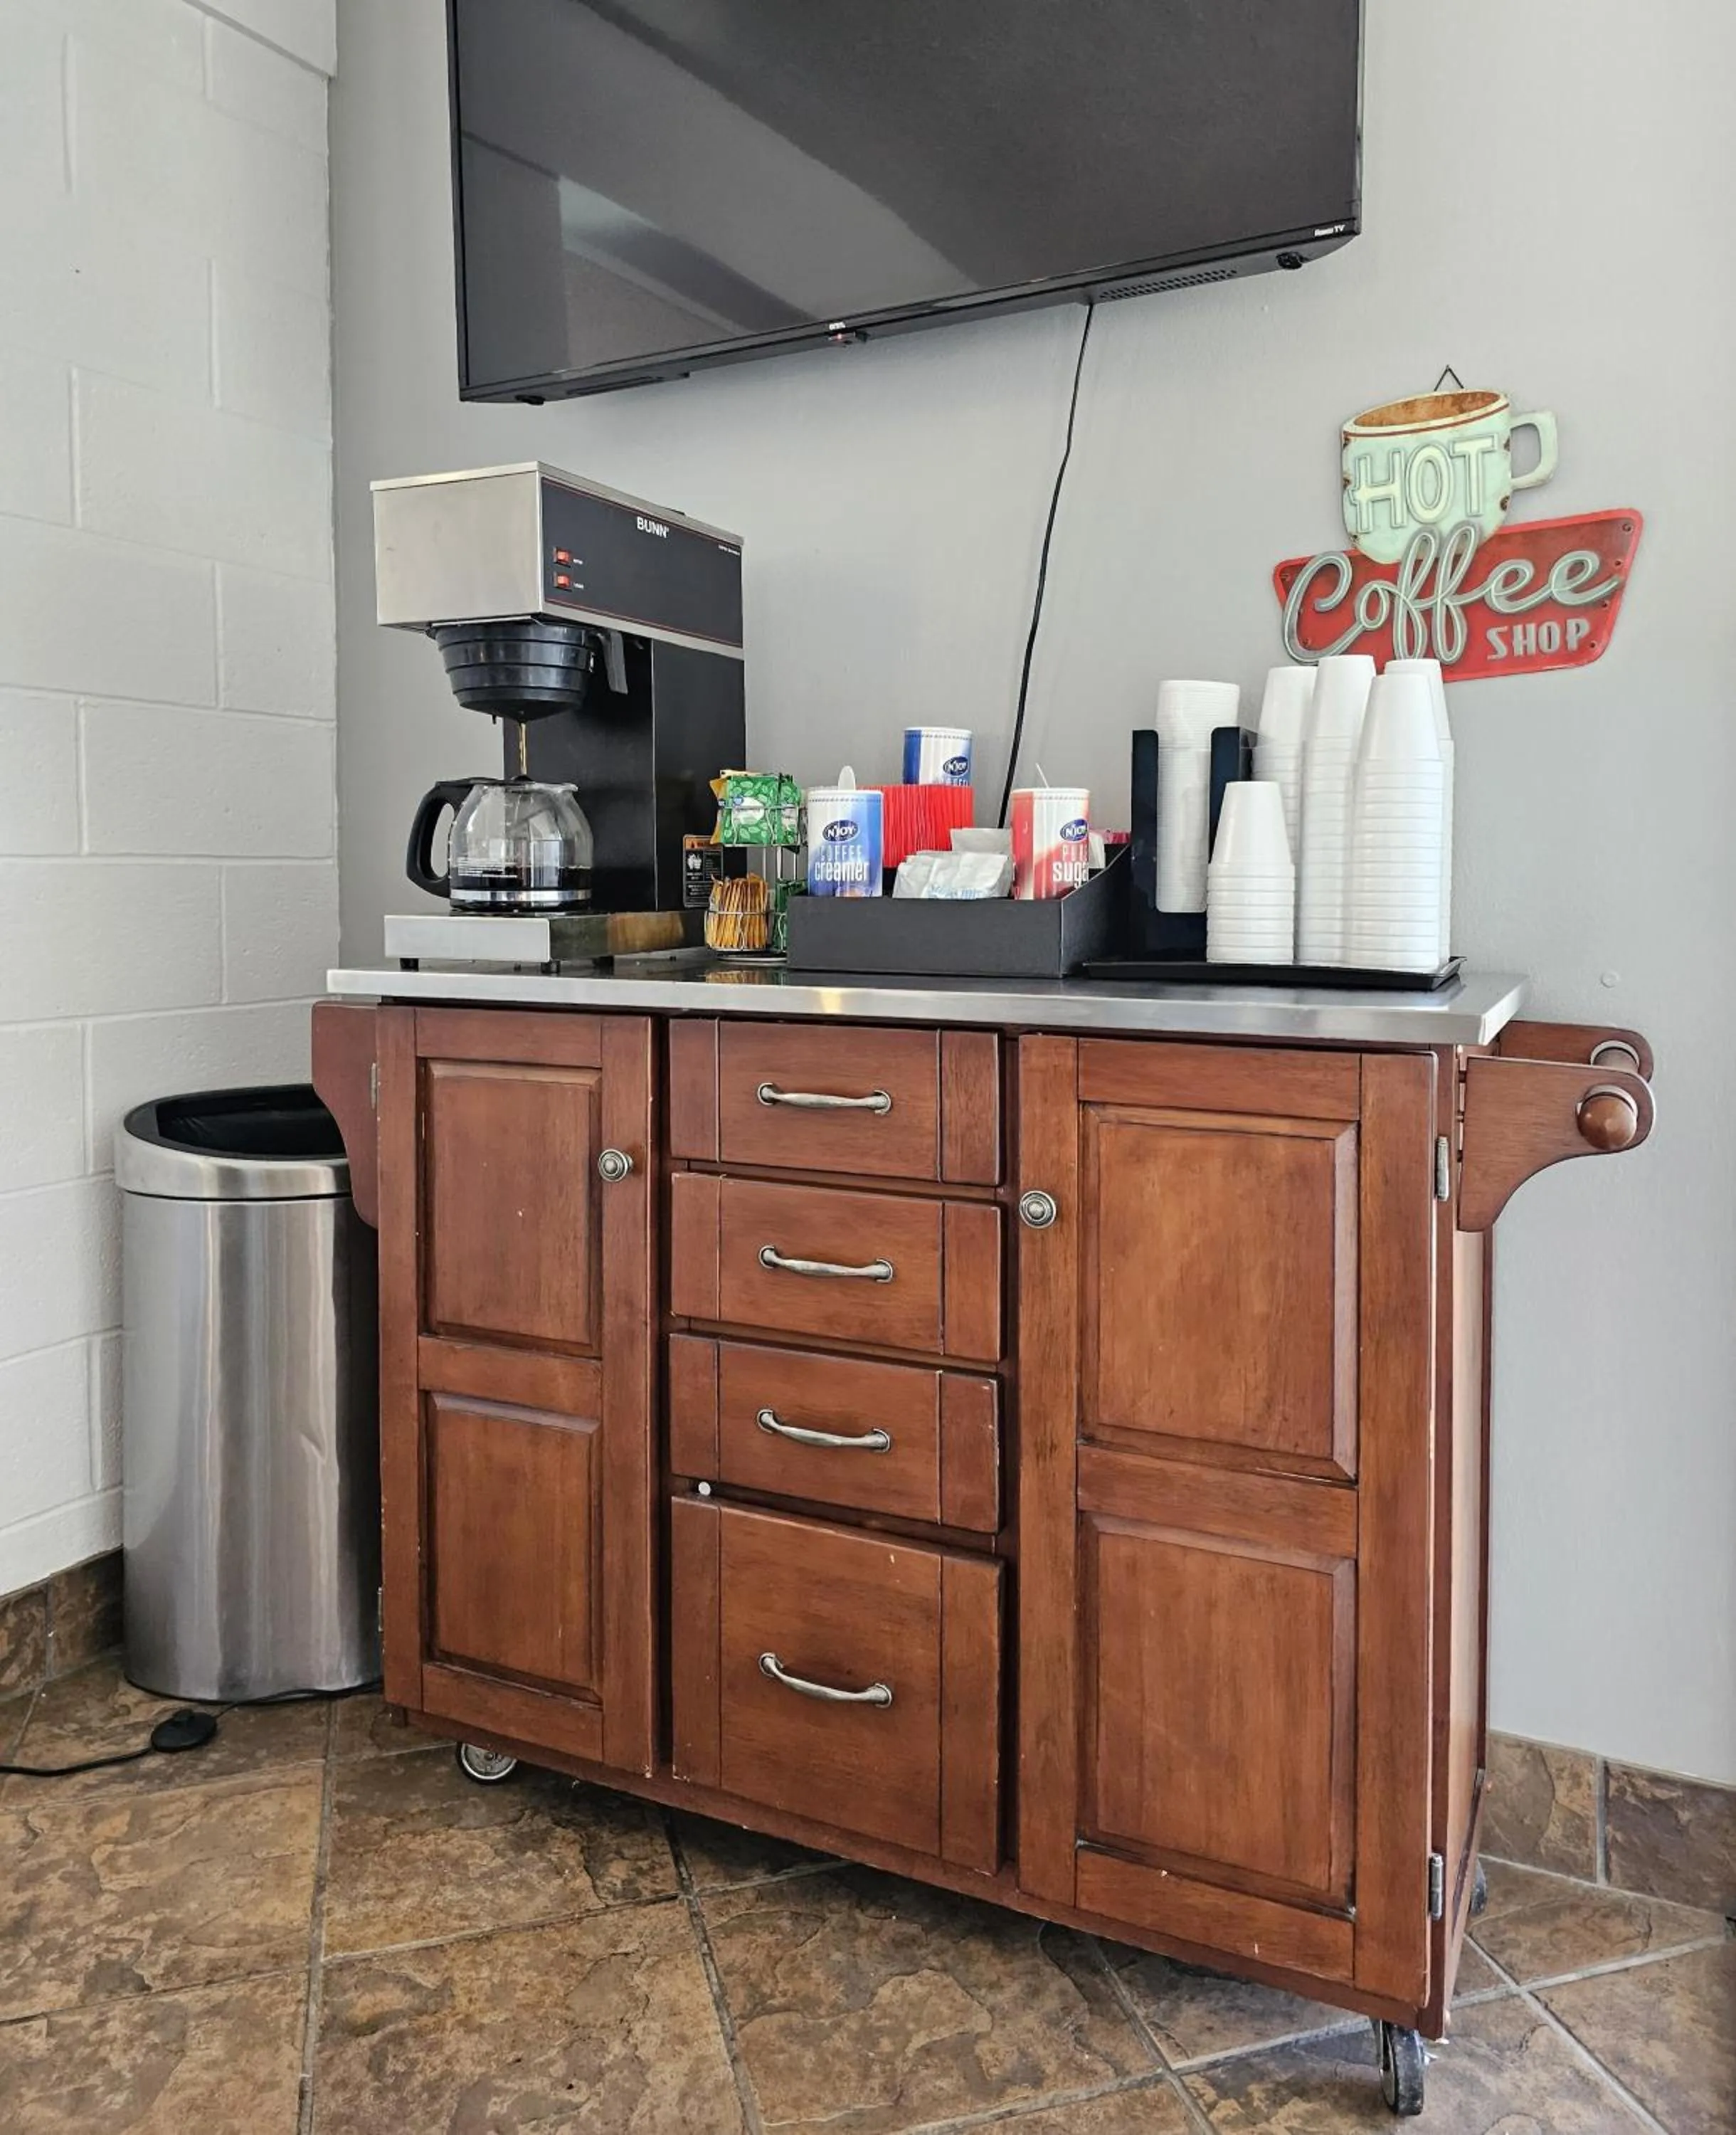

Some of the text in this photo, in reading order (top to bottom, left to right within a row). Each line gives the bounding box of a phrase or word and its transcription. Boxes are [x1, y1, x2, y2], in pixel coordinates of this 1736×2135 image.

[1348, 433, 1498, 534] HOT
[637, 516, 667, 538] BUNN
[1281, 520, 1623, 665] Coffee
[1486, 618, 1591, 660] SHOP
[820, 845, 862, 862] COFFEE
[814, 861, 869, 881] creamer
